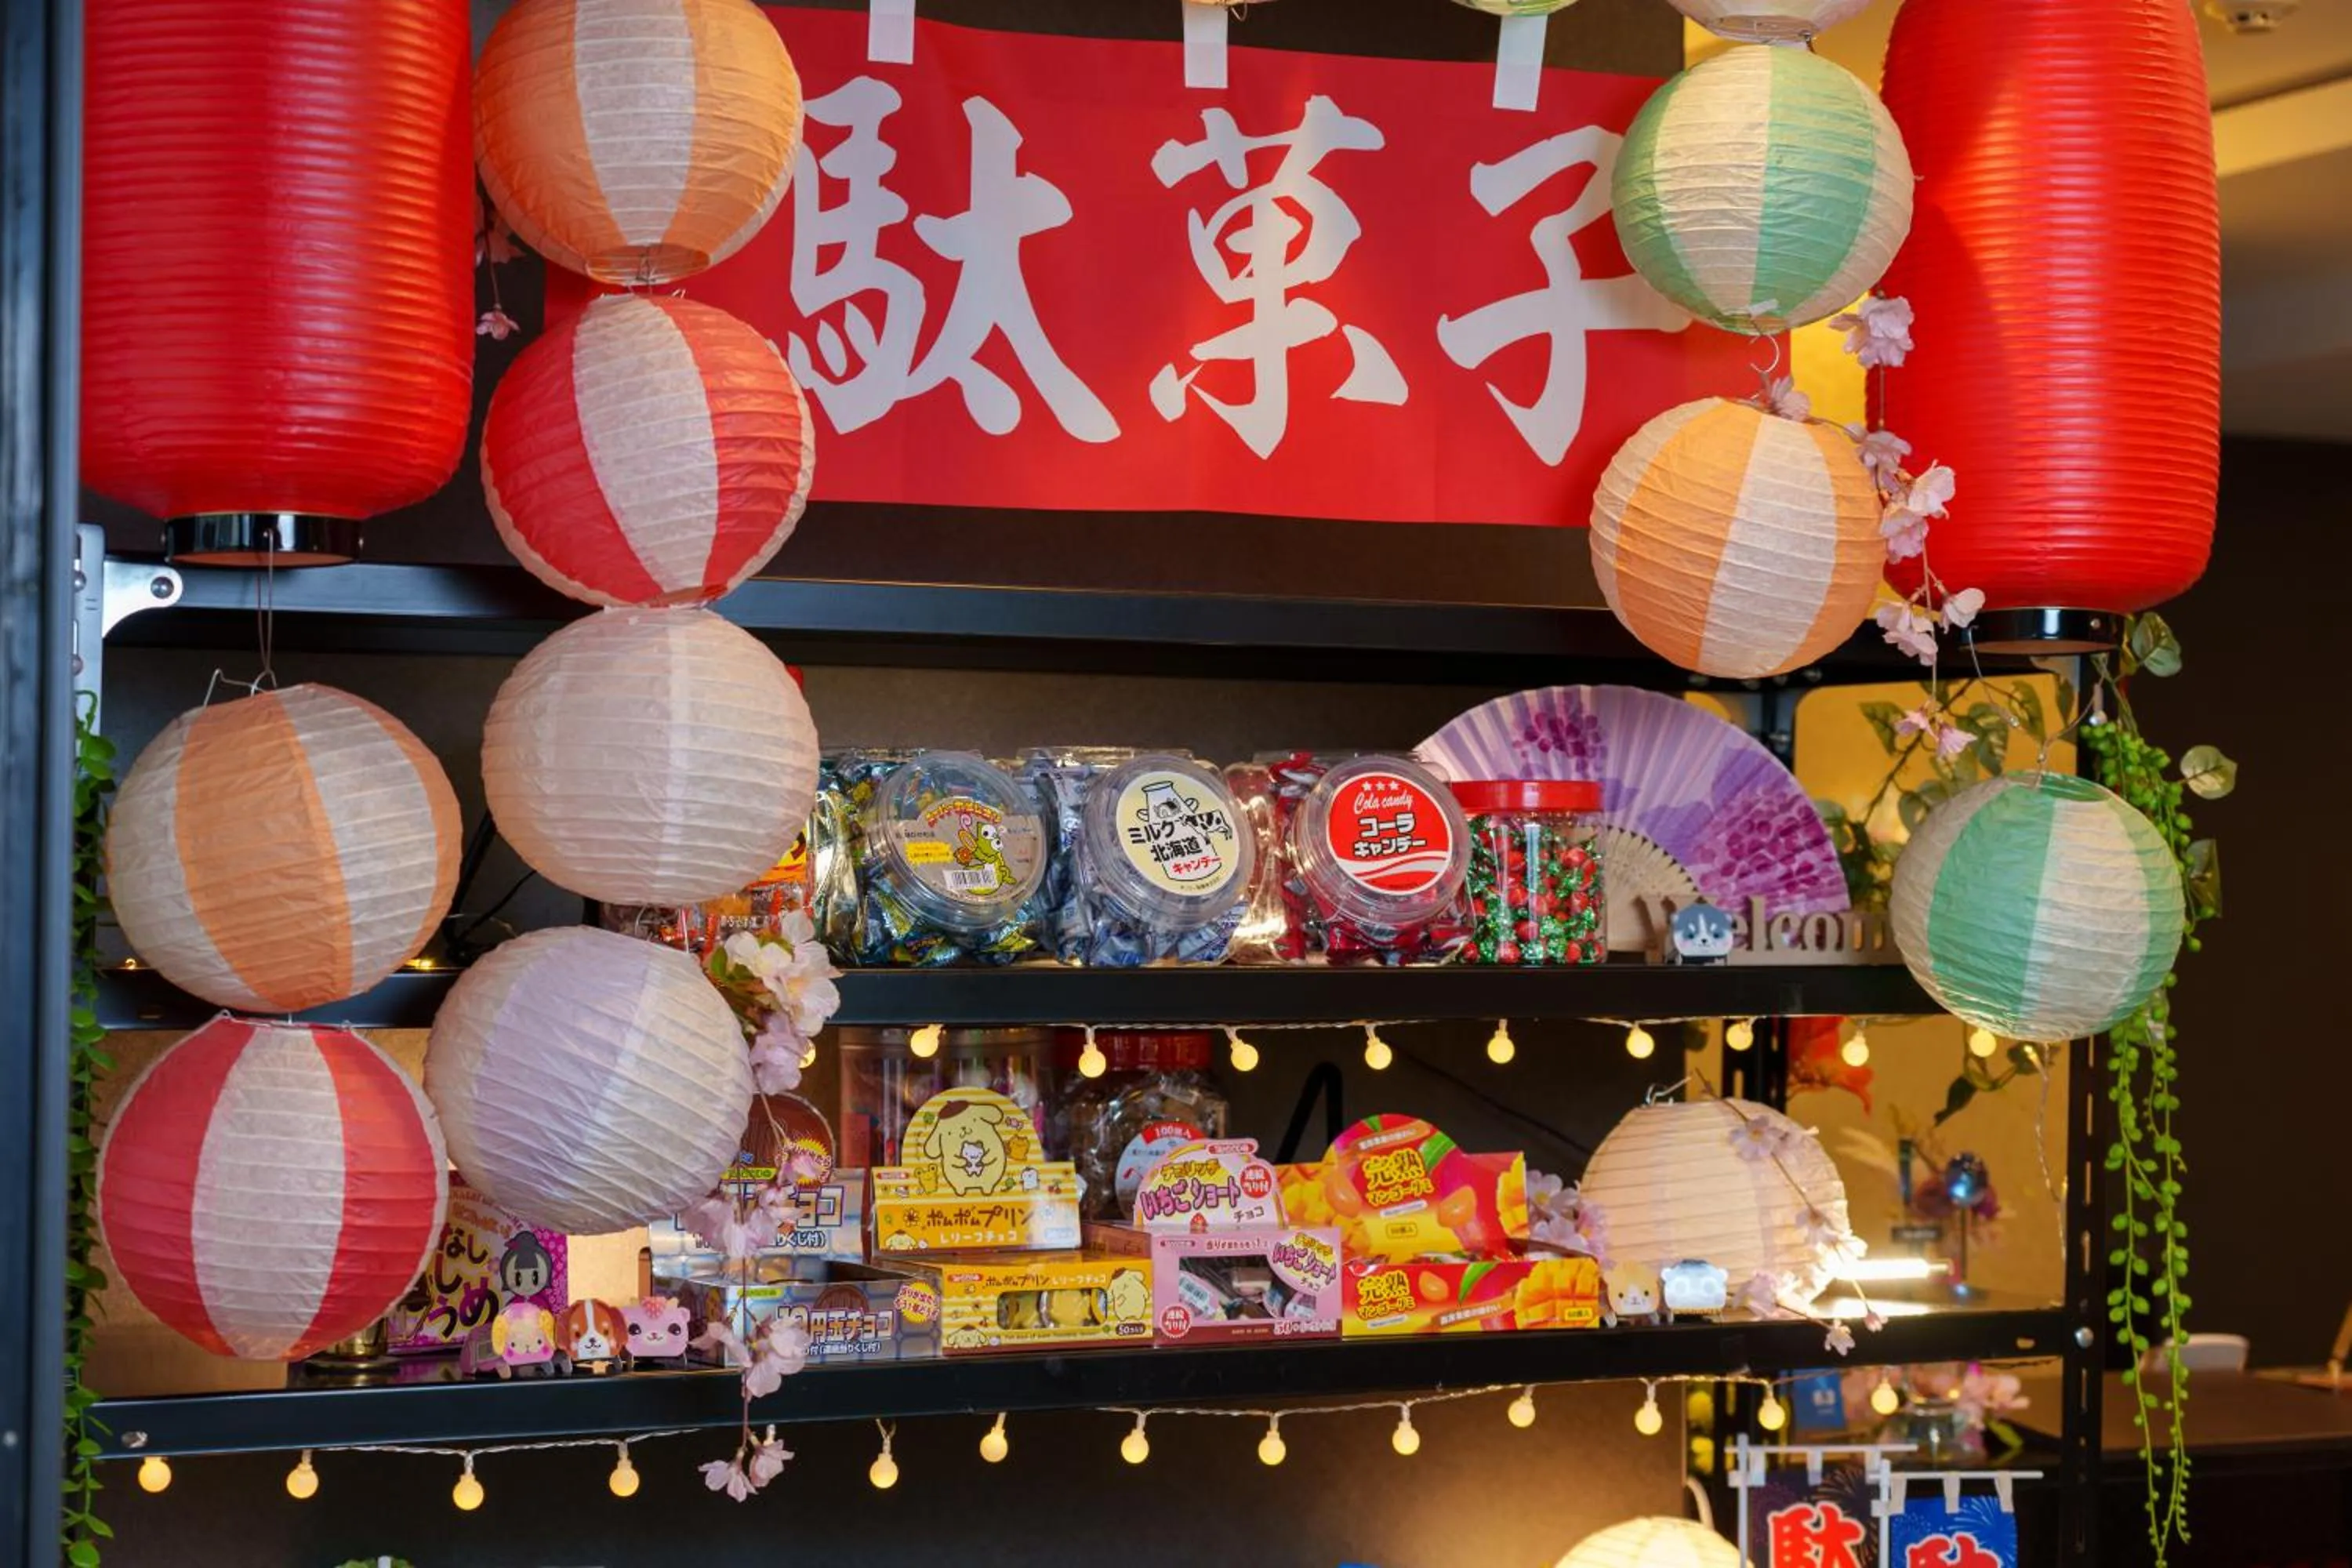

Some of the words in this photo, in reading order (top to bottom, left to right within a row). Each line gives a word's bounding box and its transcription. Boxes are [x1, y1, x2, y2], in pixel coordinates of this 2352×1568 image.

[787, 74, 1693, 468] 駄菓子
[1354, 791, 1379, 814] Cola
[1381, 789, 1413, 811] candy
[1127, 820, 1175, 844] ミルク
[1358, 812, 1416, 838] コーラ
[1150, 836, 1203, 863] 北海道
[1353, 835, 1427, 857] キャンデー
[1172, 855, 1221, 874] キャンデー
[1139, 1176, 1241, 1220] いちごショート
[1234, 1206, 1265, 1223] チョコ
